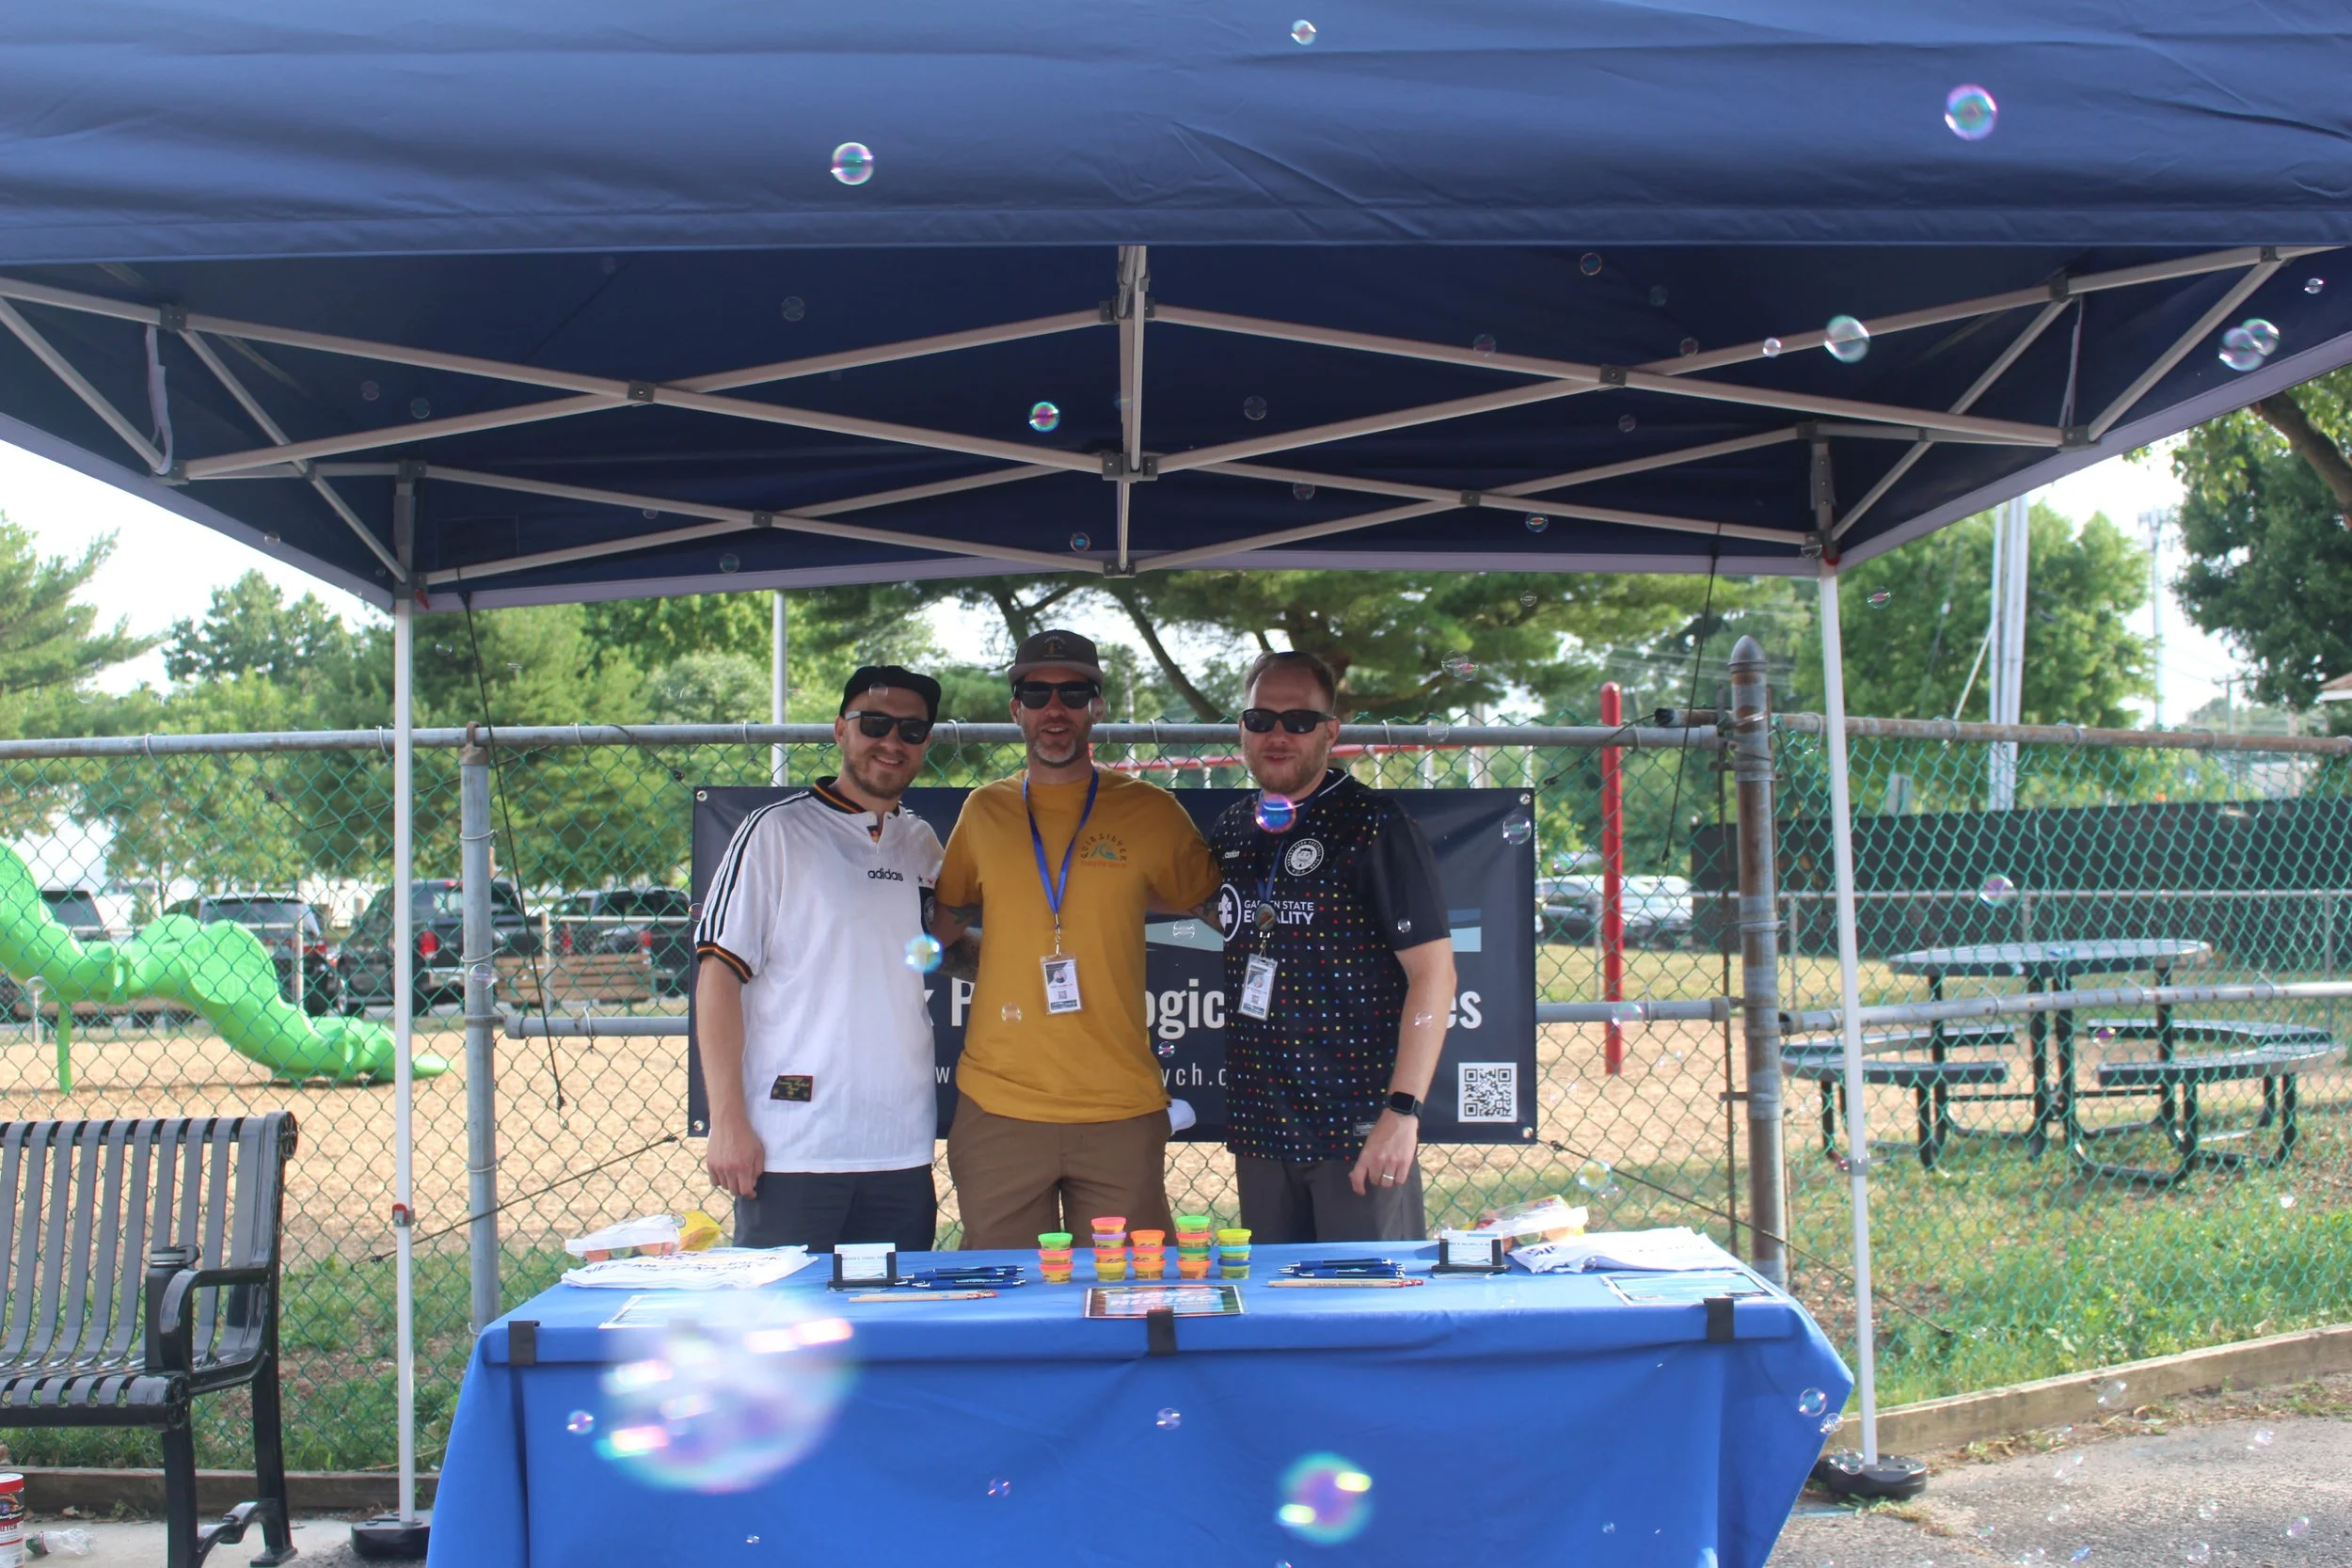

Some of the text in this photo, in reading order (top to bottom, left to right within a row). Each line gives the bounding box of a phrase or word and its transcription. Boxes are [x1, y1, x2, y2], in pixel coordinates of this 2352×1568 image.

[867, 867, 903, 881] adidas
[1244, 899, 1314, 911] GAN STATE
[1244, 910, 1314, 925] ELITY
